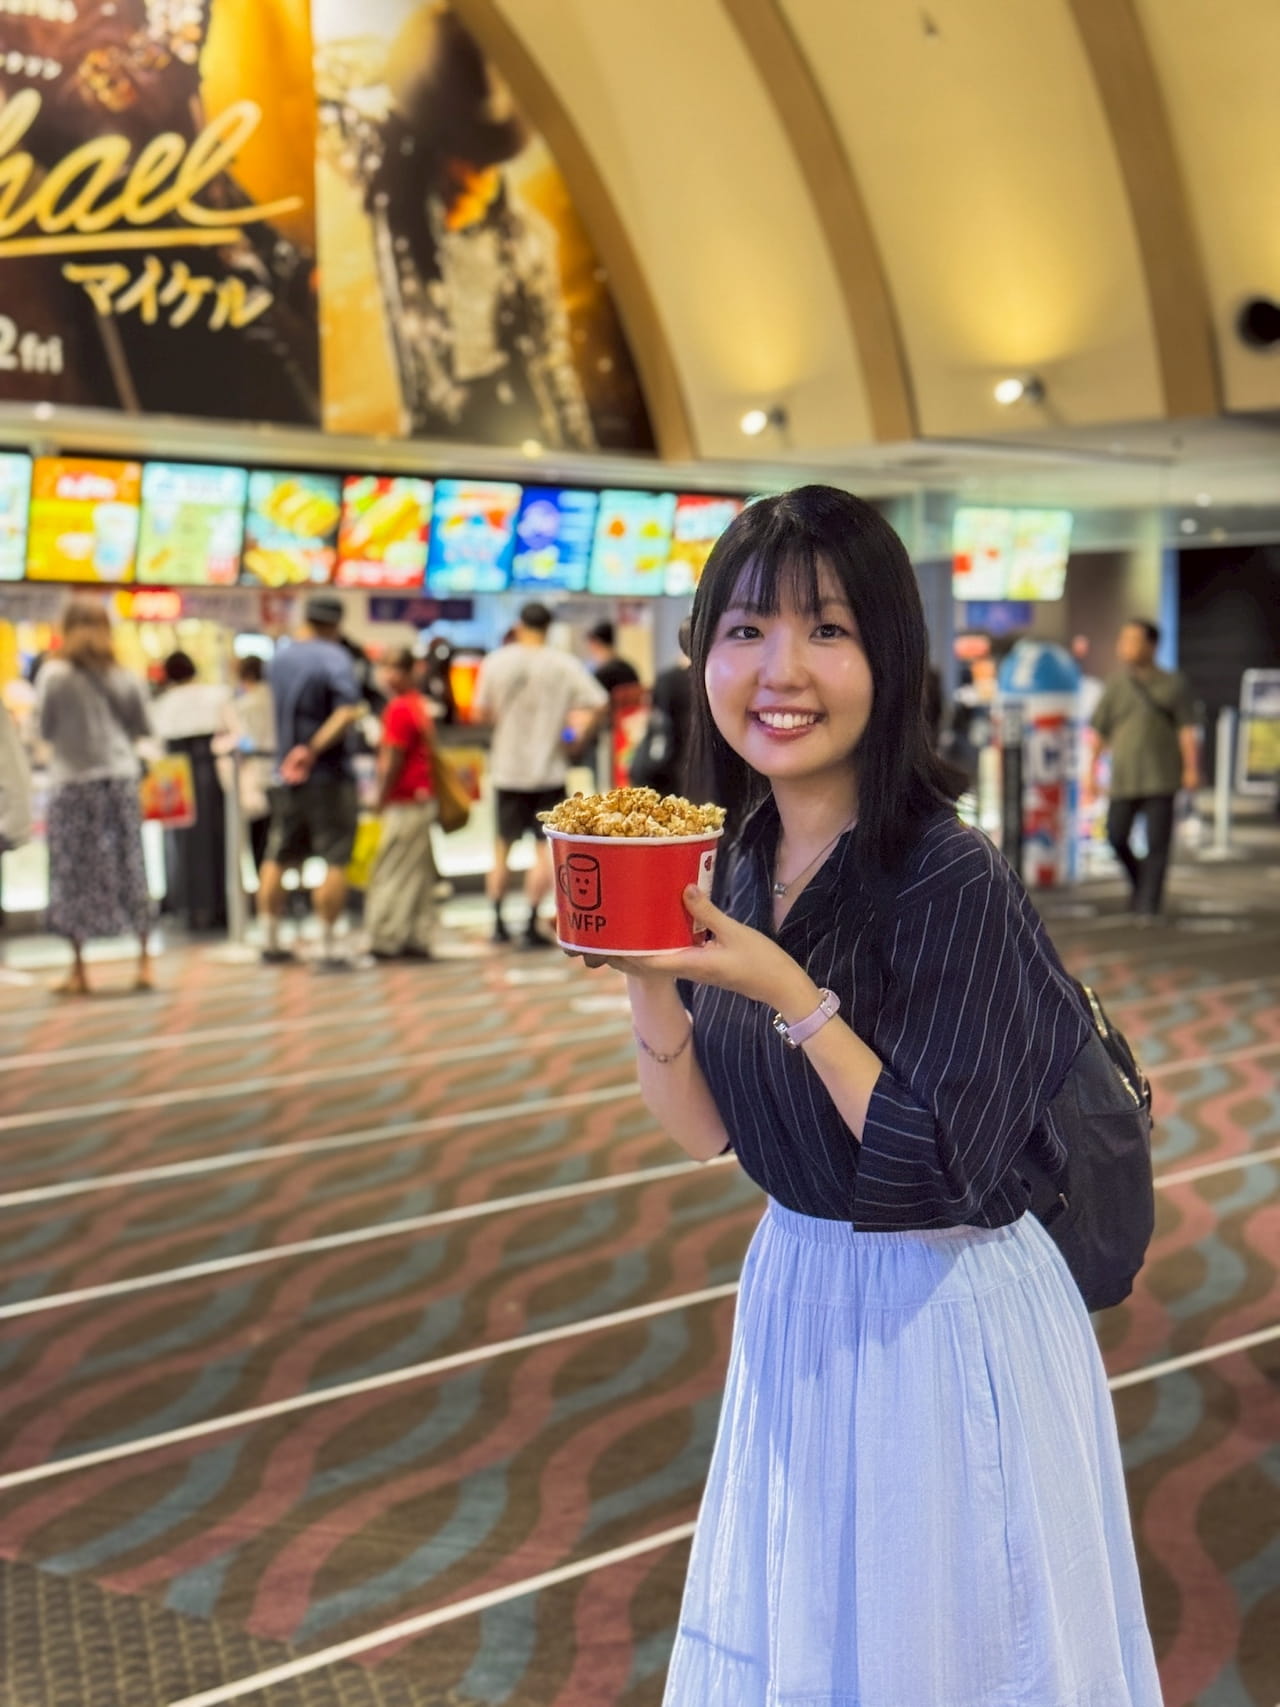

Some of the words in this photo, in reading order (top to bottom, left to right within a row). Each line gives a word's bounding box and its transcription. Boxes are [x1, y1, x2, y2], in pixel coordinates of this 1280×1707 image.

[62, 255, 274, 331] マイケル
[566, 911, 607, 933] WFP
